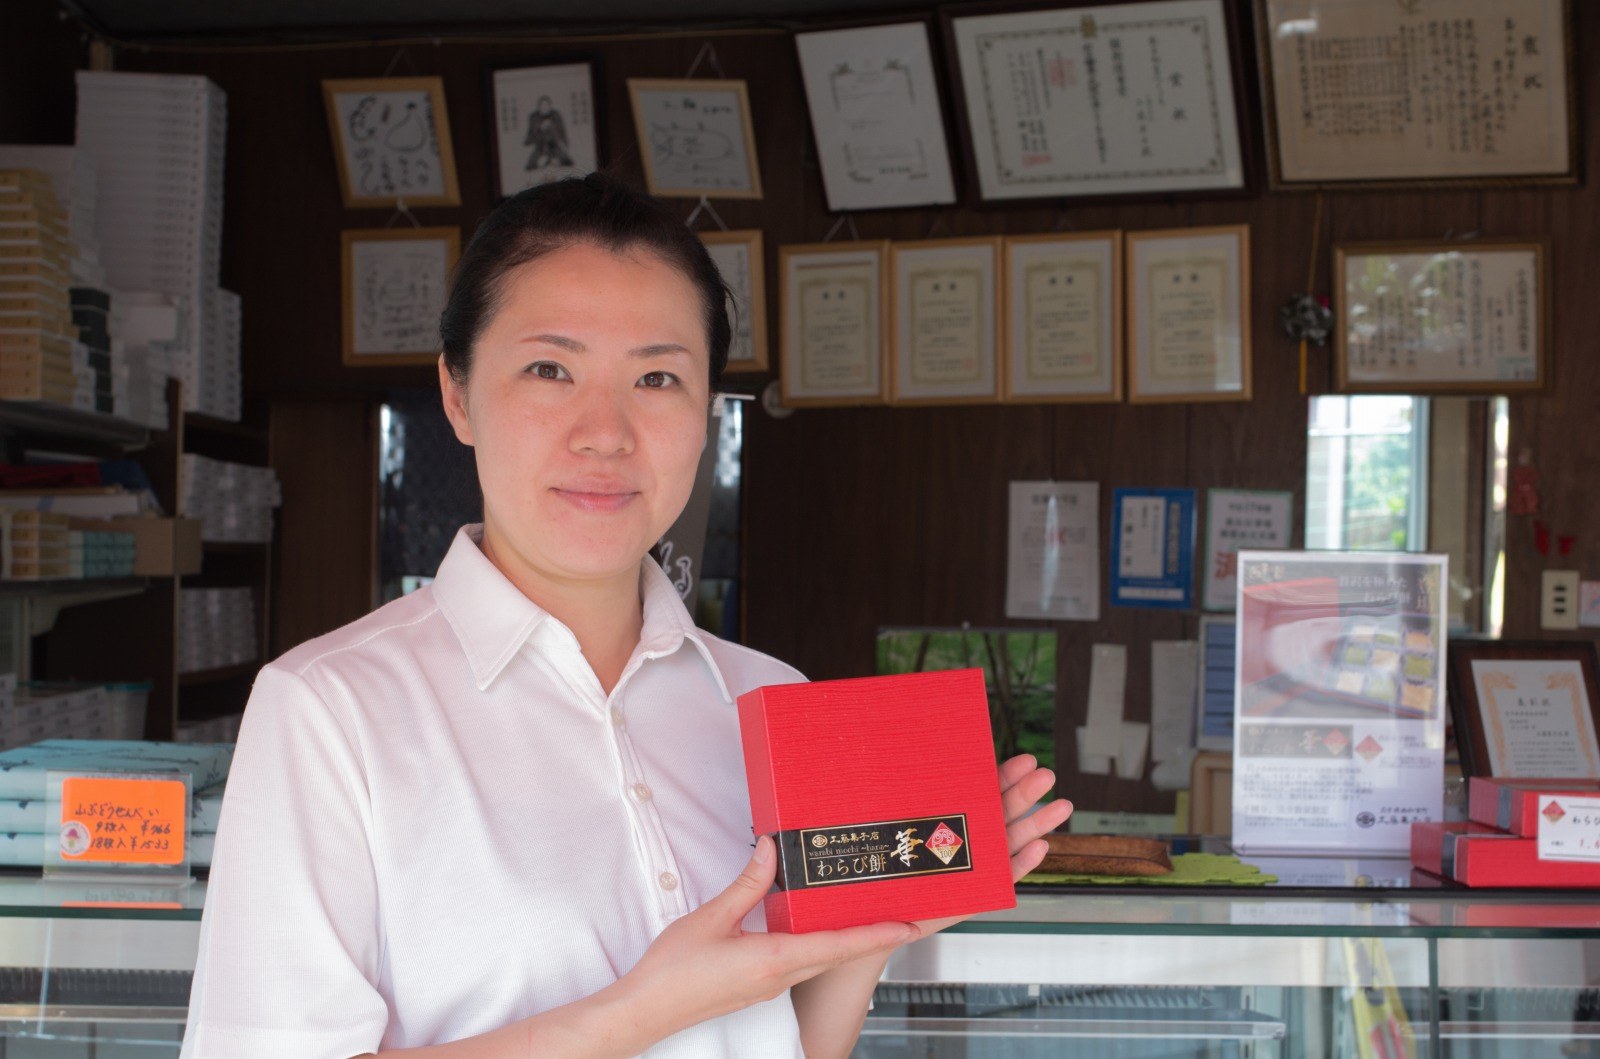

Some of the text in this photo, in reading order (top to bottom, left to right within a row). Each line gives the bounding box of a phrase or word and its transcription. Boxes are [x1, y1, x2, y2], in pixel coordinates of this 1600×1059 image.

[830, 831, 880, 844] 工藤菓子店
[890, 827, 924, 868] 華
[817, 854, 887, 878] わらび餅
